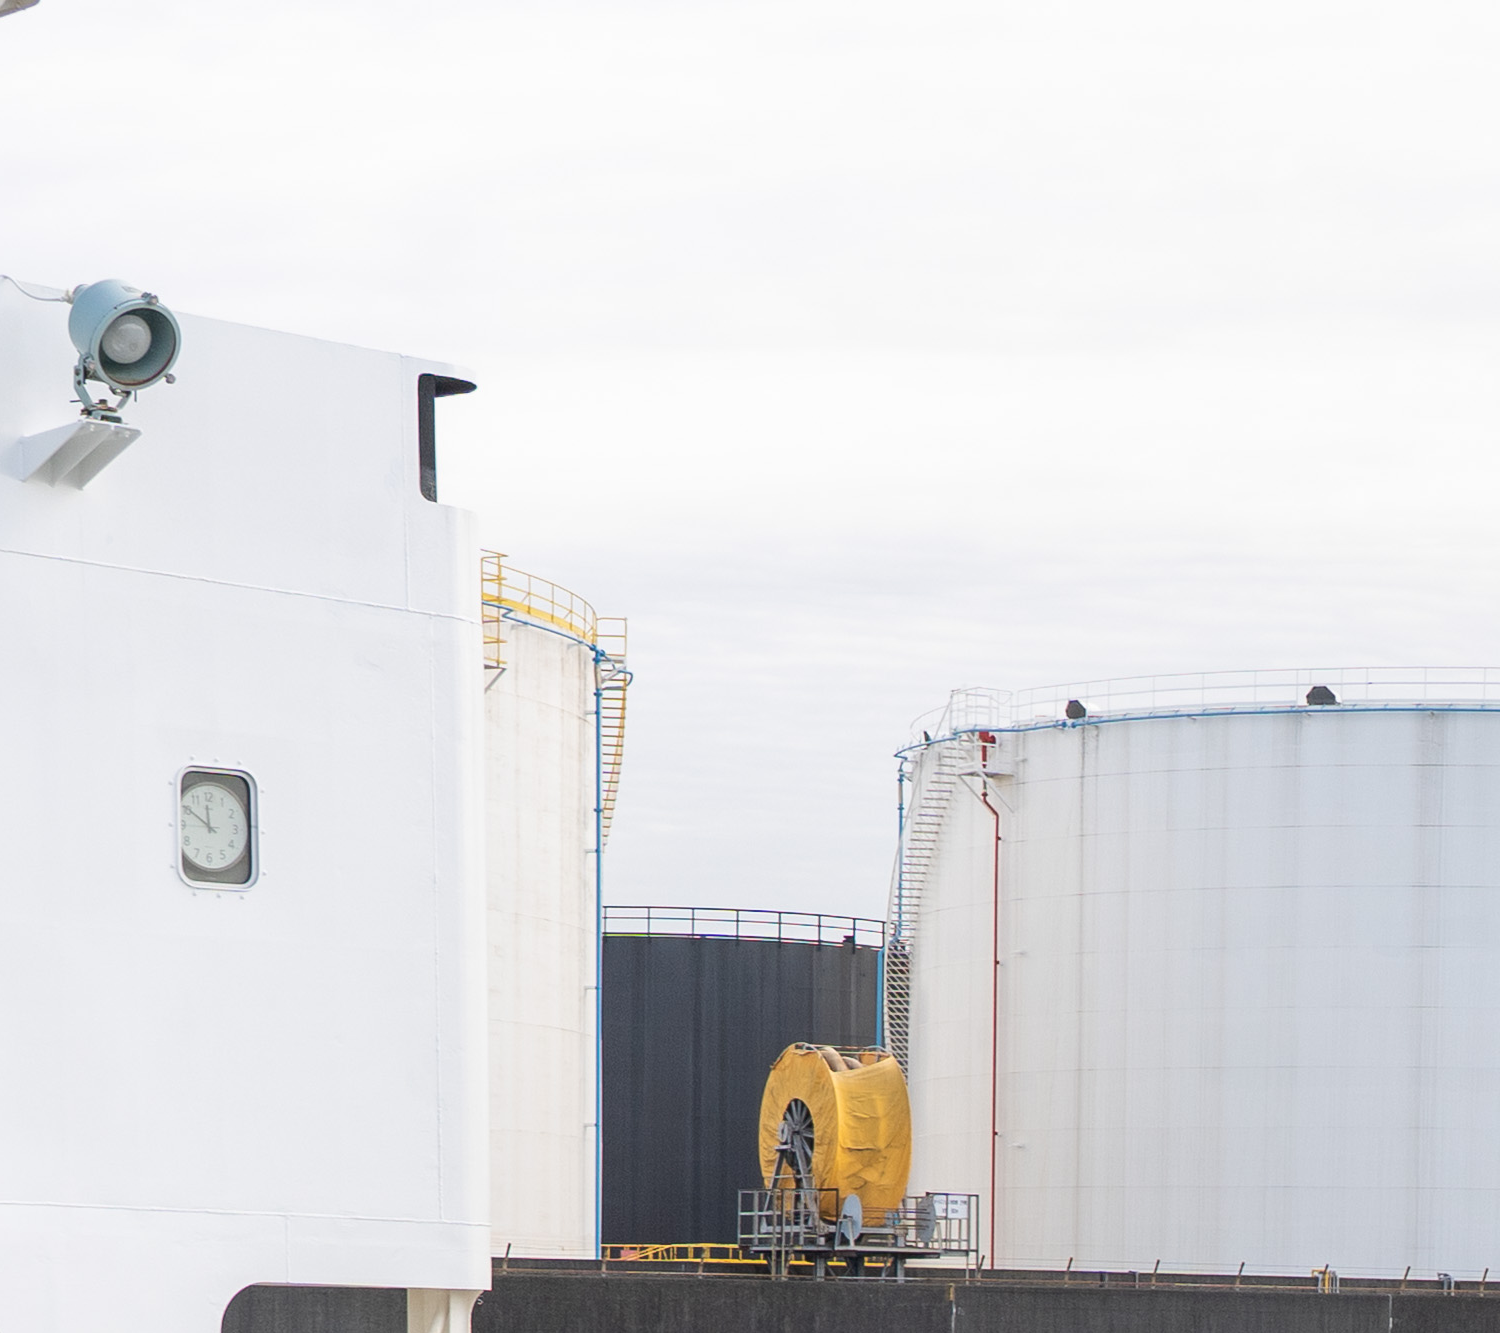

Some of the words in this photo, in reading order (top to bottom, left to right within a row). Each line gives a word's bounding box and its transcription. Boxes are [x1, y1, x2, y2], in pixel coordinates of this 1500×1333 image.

[192, 792, 199, 805] 11
[204, 792, 213, 802] 12
[228, 808, 235, 819] 2
[232, 824, 238, 835] 3
[183, 836, 190, 846] 8
[194, 847, 200, 858] 7
[206, 852, 212, 863] 6
[220, 849, 226, 860] 5
